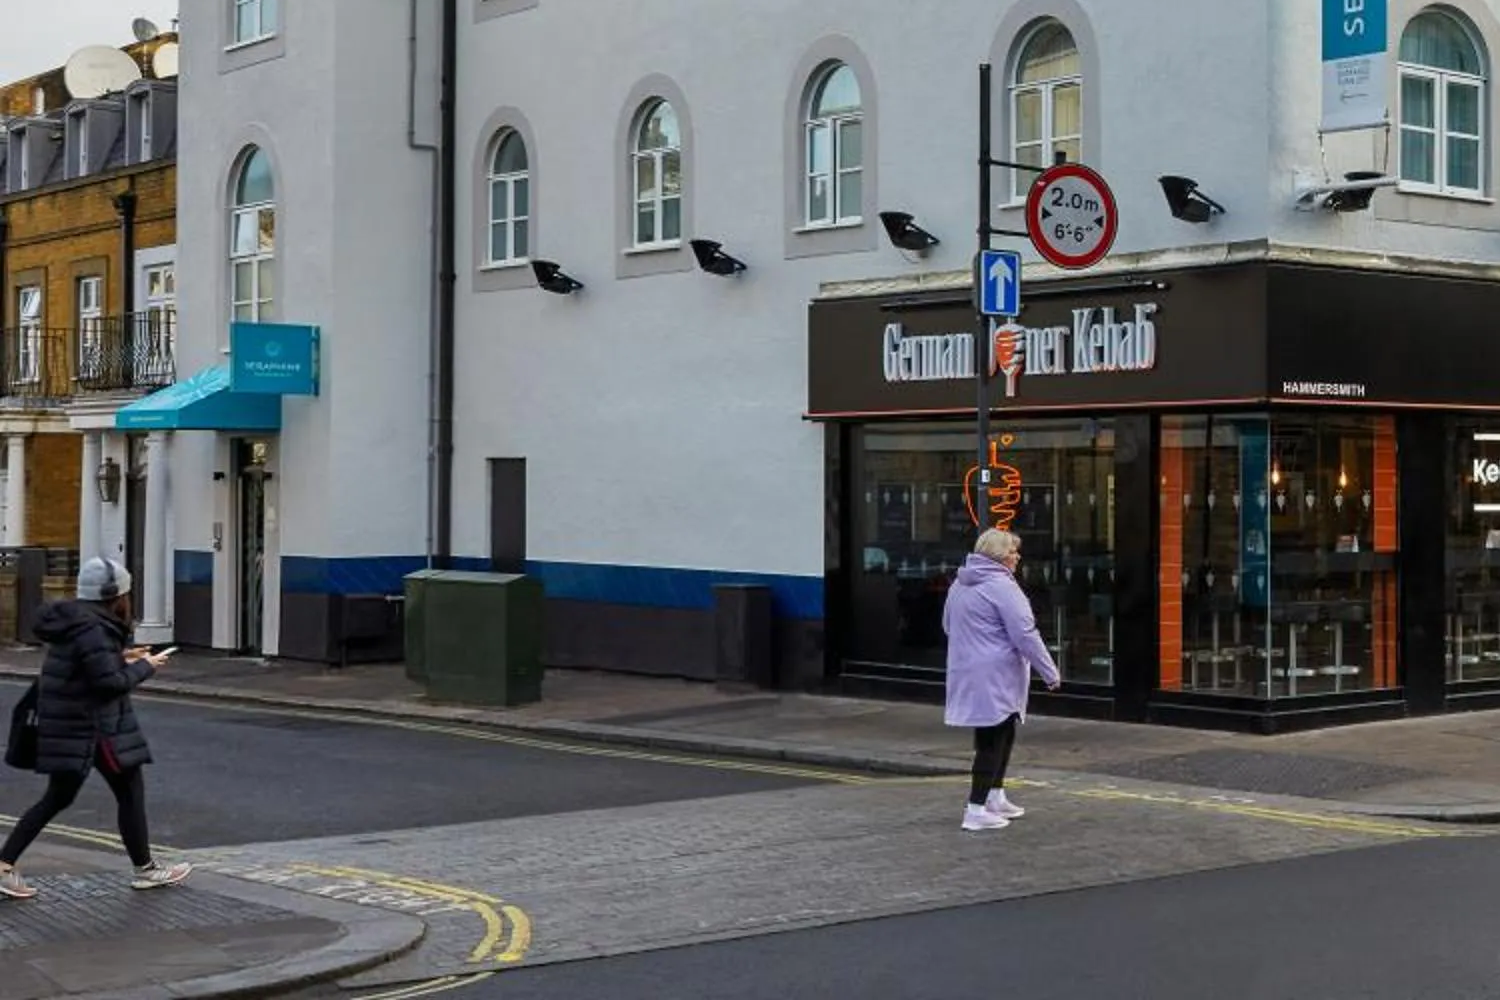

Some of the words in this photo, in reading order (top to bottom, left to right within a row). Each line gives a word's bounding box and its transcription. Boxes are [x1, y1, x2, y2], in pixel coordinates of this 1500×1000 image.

[1051, 187, 1099, 212] 2.0m
[883, 322, 975, 382] German
[1072, 303, 1157, 373] Kebab
